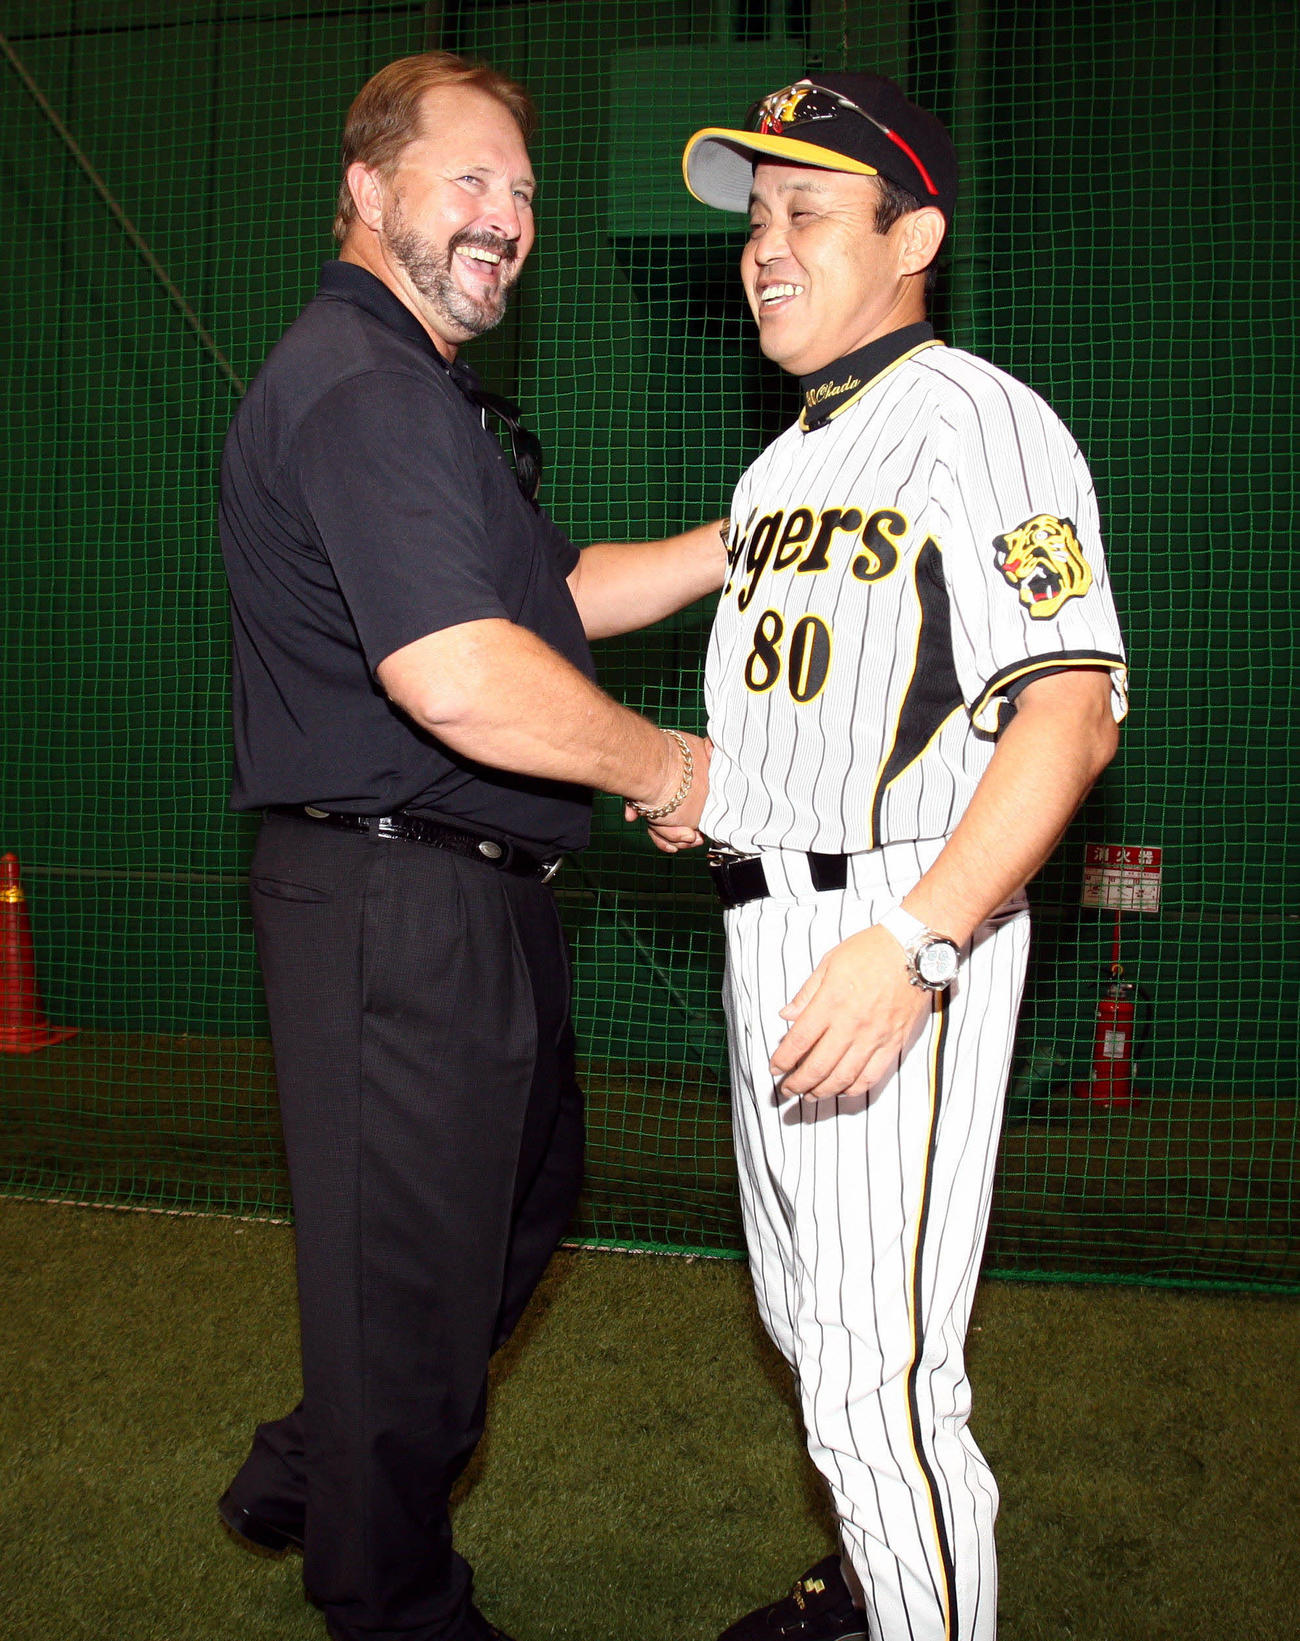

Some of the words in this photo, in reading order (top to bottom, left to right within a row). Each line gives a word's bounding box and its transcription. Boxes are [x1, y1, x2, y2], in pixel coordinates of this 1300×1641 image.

[744, 609, 831, 704] 80
[1094, 847, 1154, 864] 消火器
